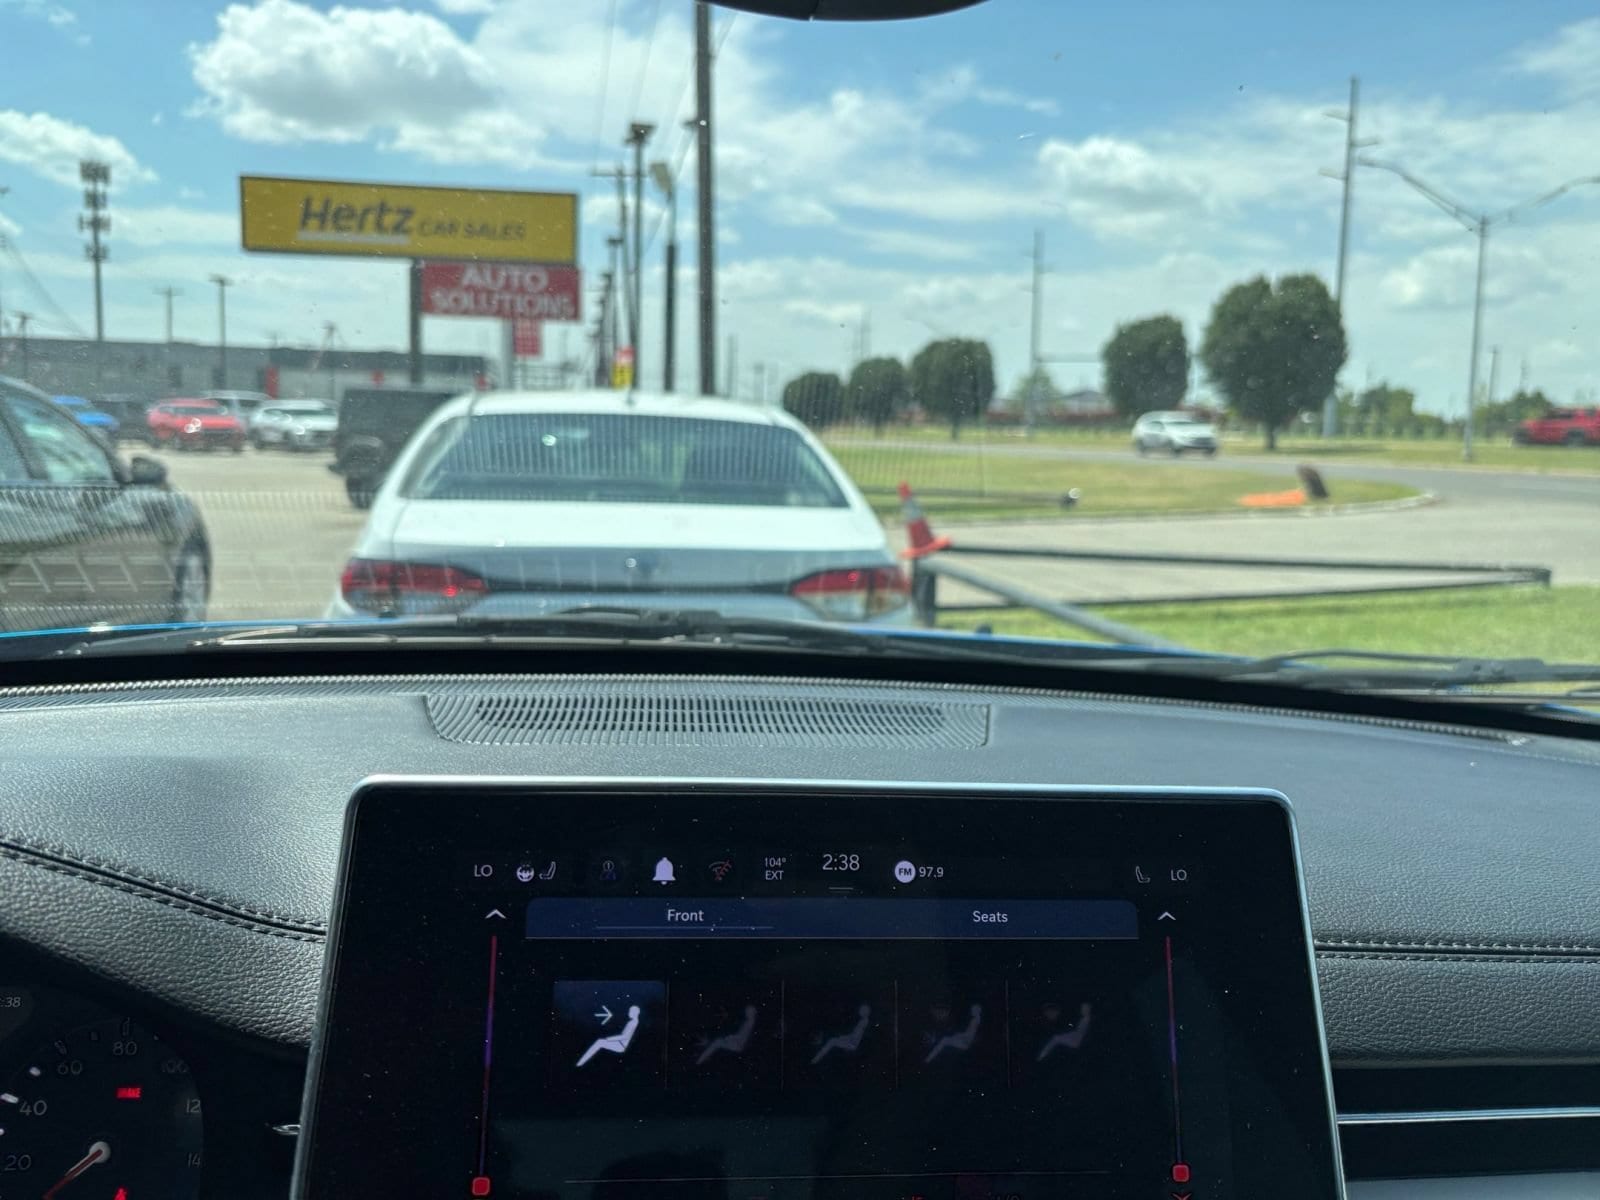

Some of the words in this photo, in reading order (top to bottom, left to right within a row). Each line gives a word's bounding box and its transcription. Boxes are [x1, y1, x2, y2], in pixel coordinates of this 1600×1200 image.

[300, 194, 415, 235] Hertz
[417, 218, 459, 239] CAR
[463, 219, 526, 241] SALES
[461, 263, 549, 293] AUTO
[430, 290, 577, 320] SOLUTIONS
[763, 856, 787, 869] 104°
[822, 853, 861, 872] 2:38
[473, 863, 493, 879] LO
[764, 869, 785, 882] EXT
[897, 866, 913, 878] FM
[918, 865, 945, 879] 97.9
[1170, 869, 1187, 882] LO
[666, 908, 705, 923] Front
[971, 909, 1009, 924] Seats
[112, 1040, 138, 1056] 80
[56, 1060, 84, 1075] 60
[19, 1099, 48, 1117] 40
[4, 1154, 32, 1172] 20
